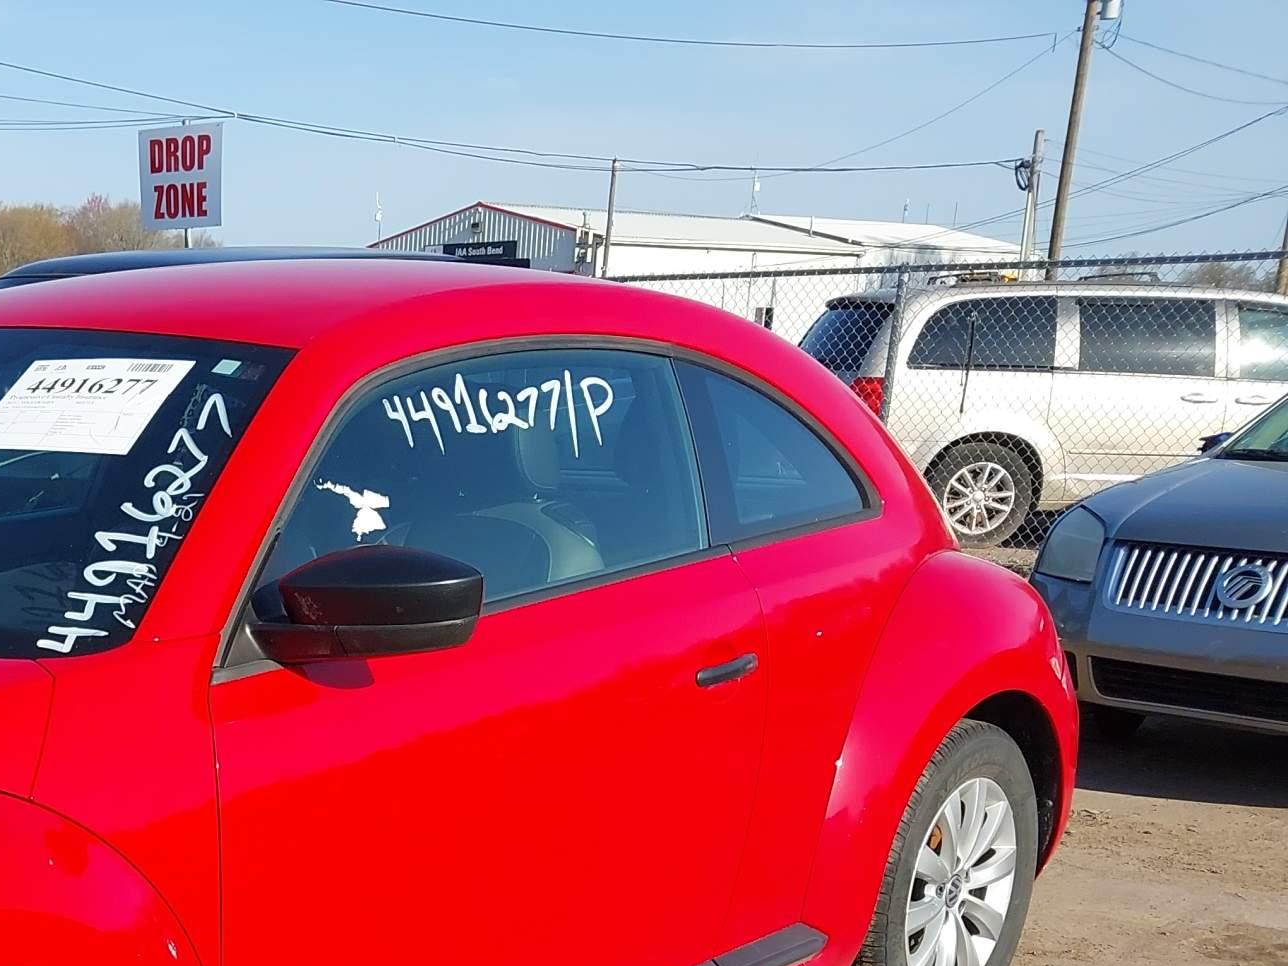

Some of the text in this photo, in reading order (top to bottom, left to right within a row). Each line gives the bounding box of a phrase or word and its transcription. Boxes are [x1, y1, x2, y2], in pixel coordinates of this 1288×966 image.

[149, 134, 212, 174] DROP
[153, 181, 208, 220] ZONE
[455, 245, 504, 257] IAA South Bend
[25, 377, 159, 395] 44916277
[36, 392, 233, 654] 44916277
